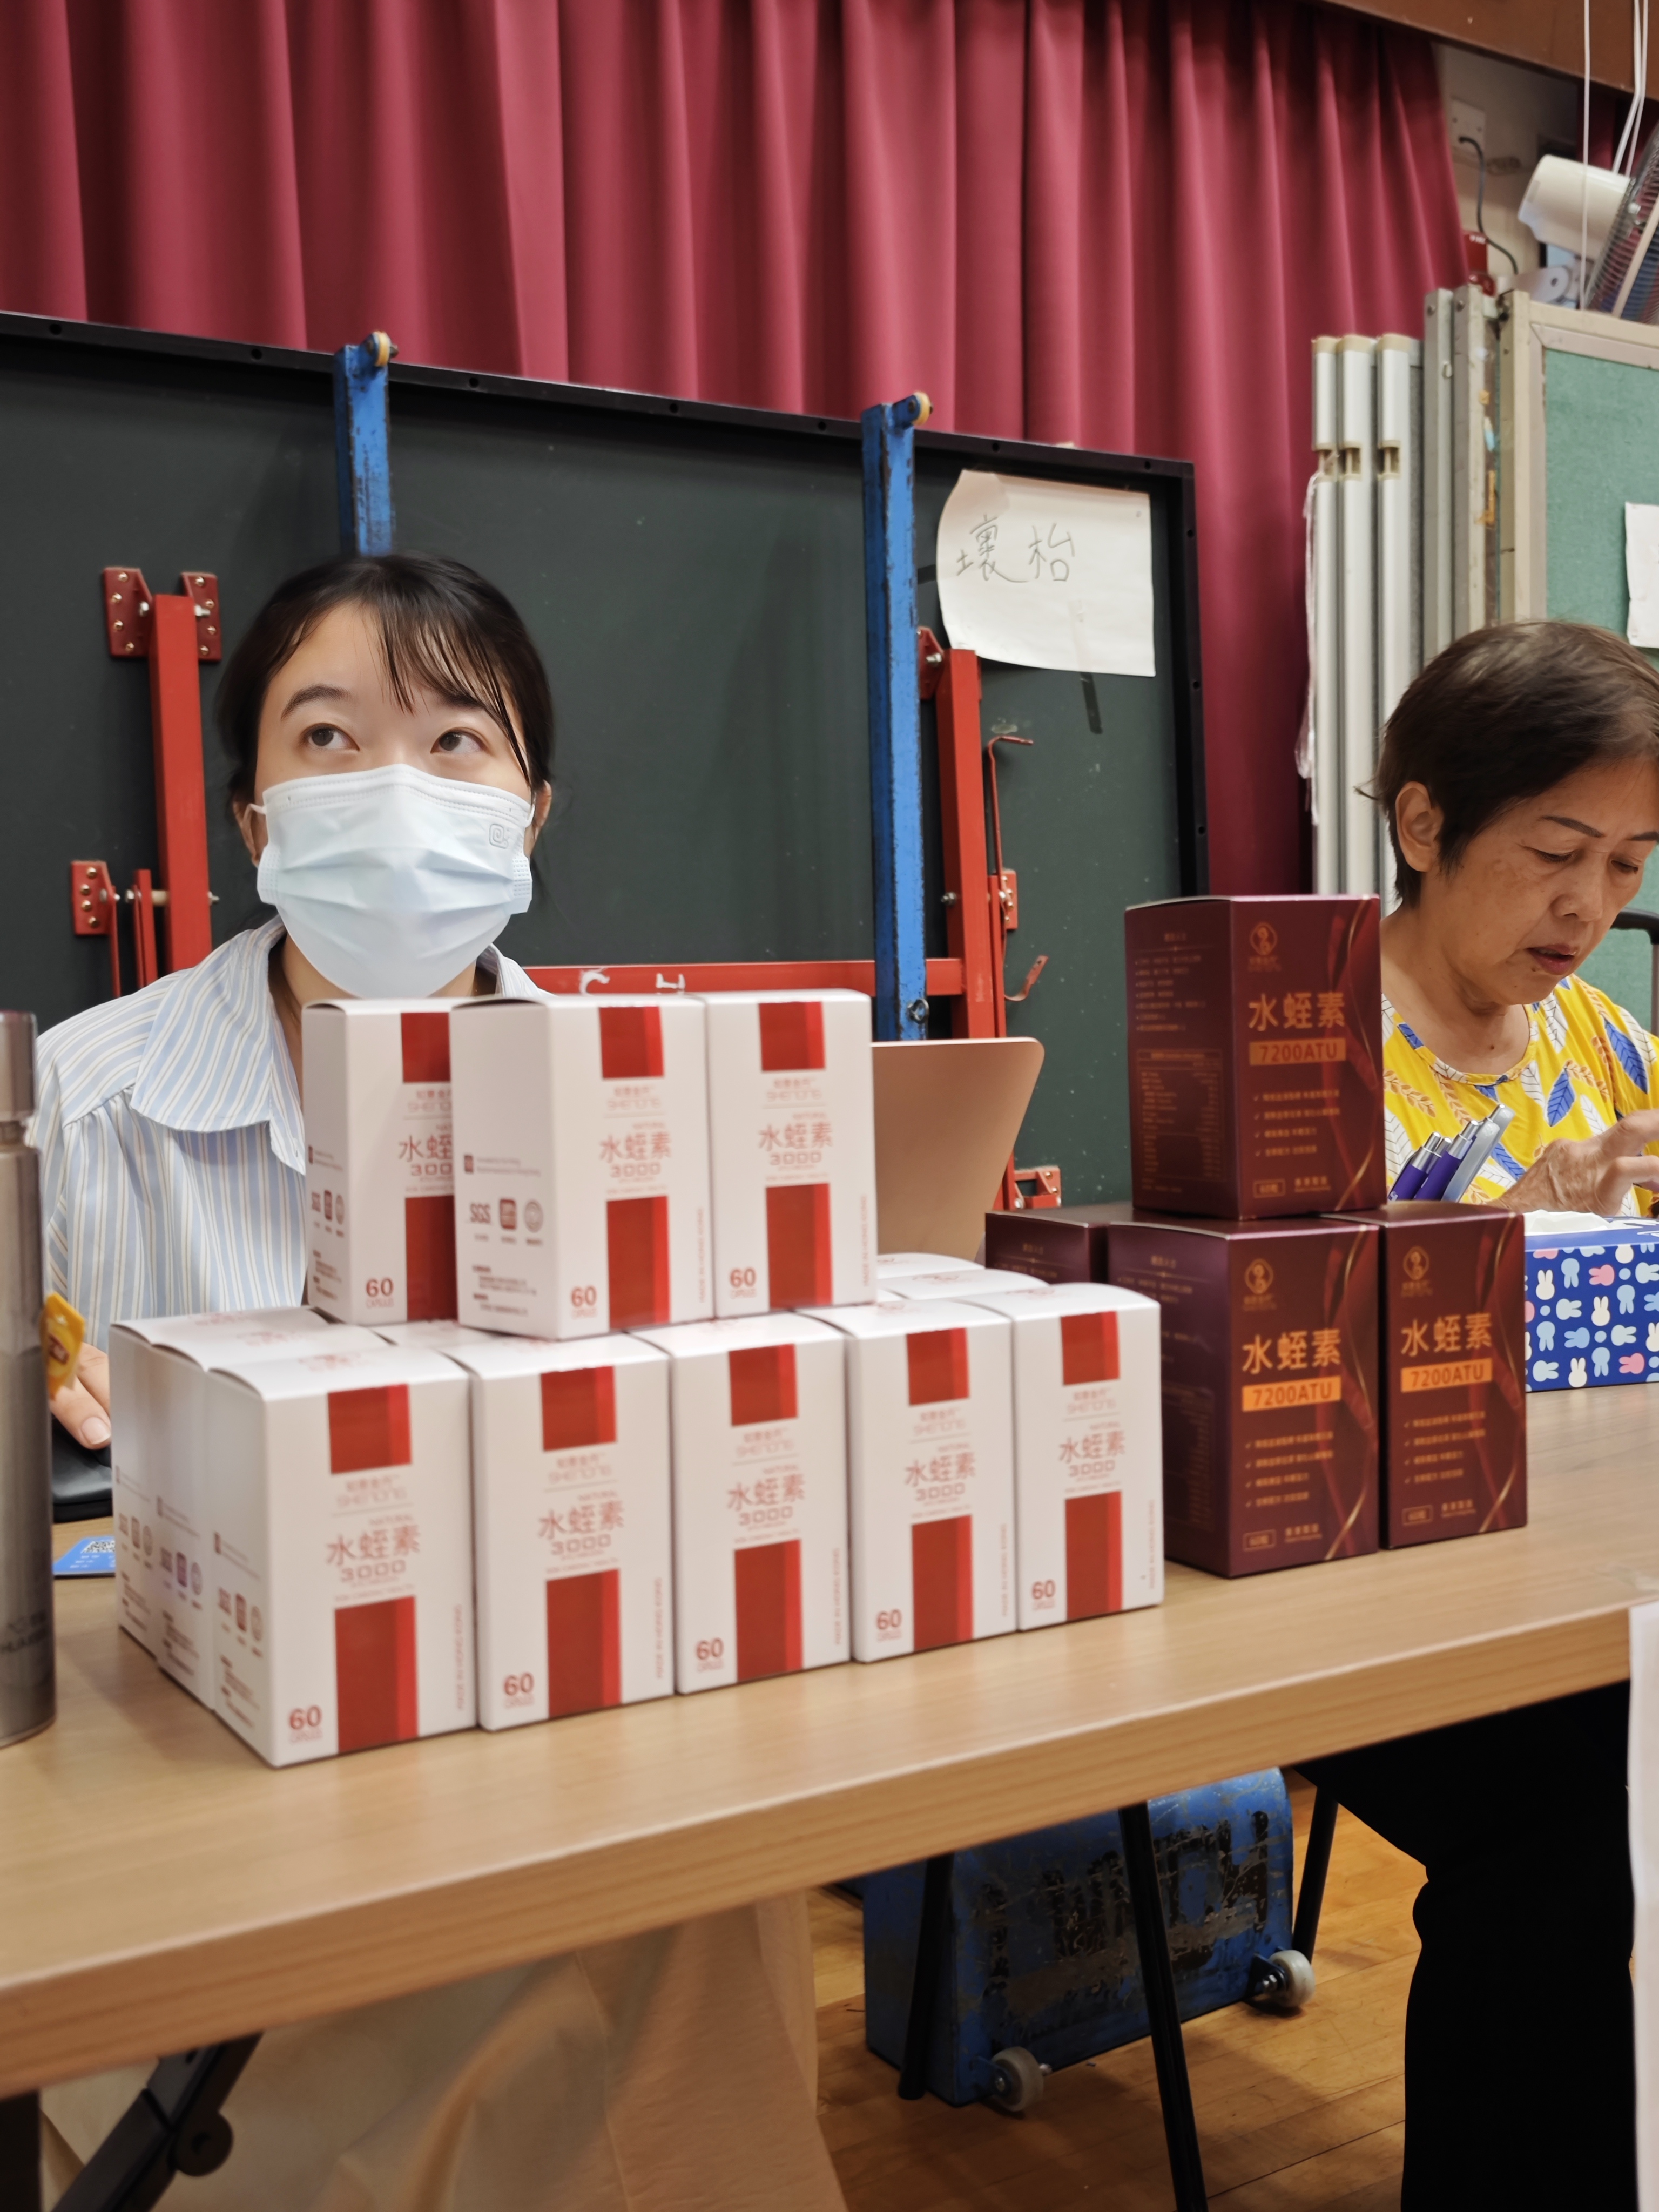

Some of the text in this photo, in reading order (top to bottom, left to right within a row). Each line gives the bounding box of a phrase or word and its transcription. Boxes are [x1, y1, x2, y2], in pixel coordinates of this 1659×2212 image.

[1249, 990, 1345, 1031] 水蛭素
[1259, 1043, 1338, 1062] 7200ATU
[599, 1132, 671, 1163] 水蛭素
[758, 1122, 832, 1151] 水蛭素
[610, 1162, 661, 1177] 3000
[770, 1151, 821, 1165] 3000
[470, 1203, 491, 1224] SGS
[366, 1278, 394, 1297] 60
[730, 1267, 756, 1287] 60
[571, 1286, 597, 1306] 60
[1401, 1312, 1492, 1357] 水蛭素
[1242, 1328, 1341, 1374] 水蛭素
[1410, 1364, 1484, 1388] 7200ATU
[1253, 1382, 1333, 1407] 7200ATU
[1059, 1431, 1125, 1464] 水蛭素
[905, 1452, 975, 1487] 水蛭素
[1069, 1460, 1115, 1477] 3000
[727, 1474, 805, 1511] 水蛭素
[916, 1482, 966, 1501] 3000
[538, 1501, 624, 1539] 水蛭素
[739, 1506, 793, 1525] 3000
[326, 1525, 421, 1566] 水蛭素
[552, 1534, 611, 1555] 3000
[341, 1560, 406, 1582] 3000
[1032, 1579, 1056, 1600] 60
[876, 1608, 902, 1629] 60
[697, 1637, 724, 1660] 60
[504, 1672, 535, 1696] 60
[289, 1704, 322, 1729] 60
